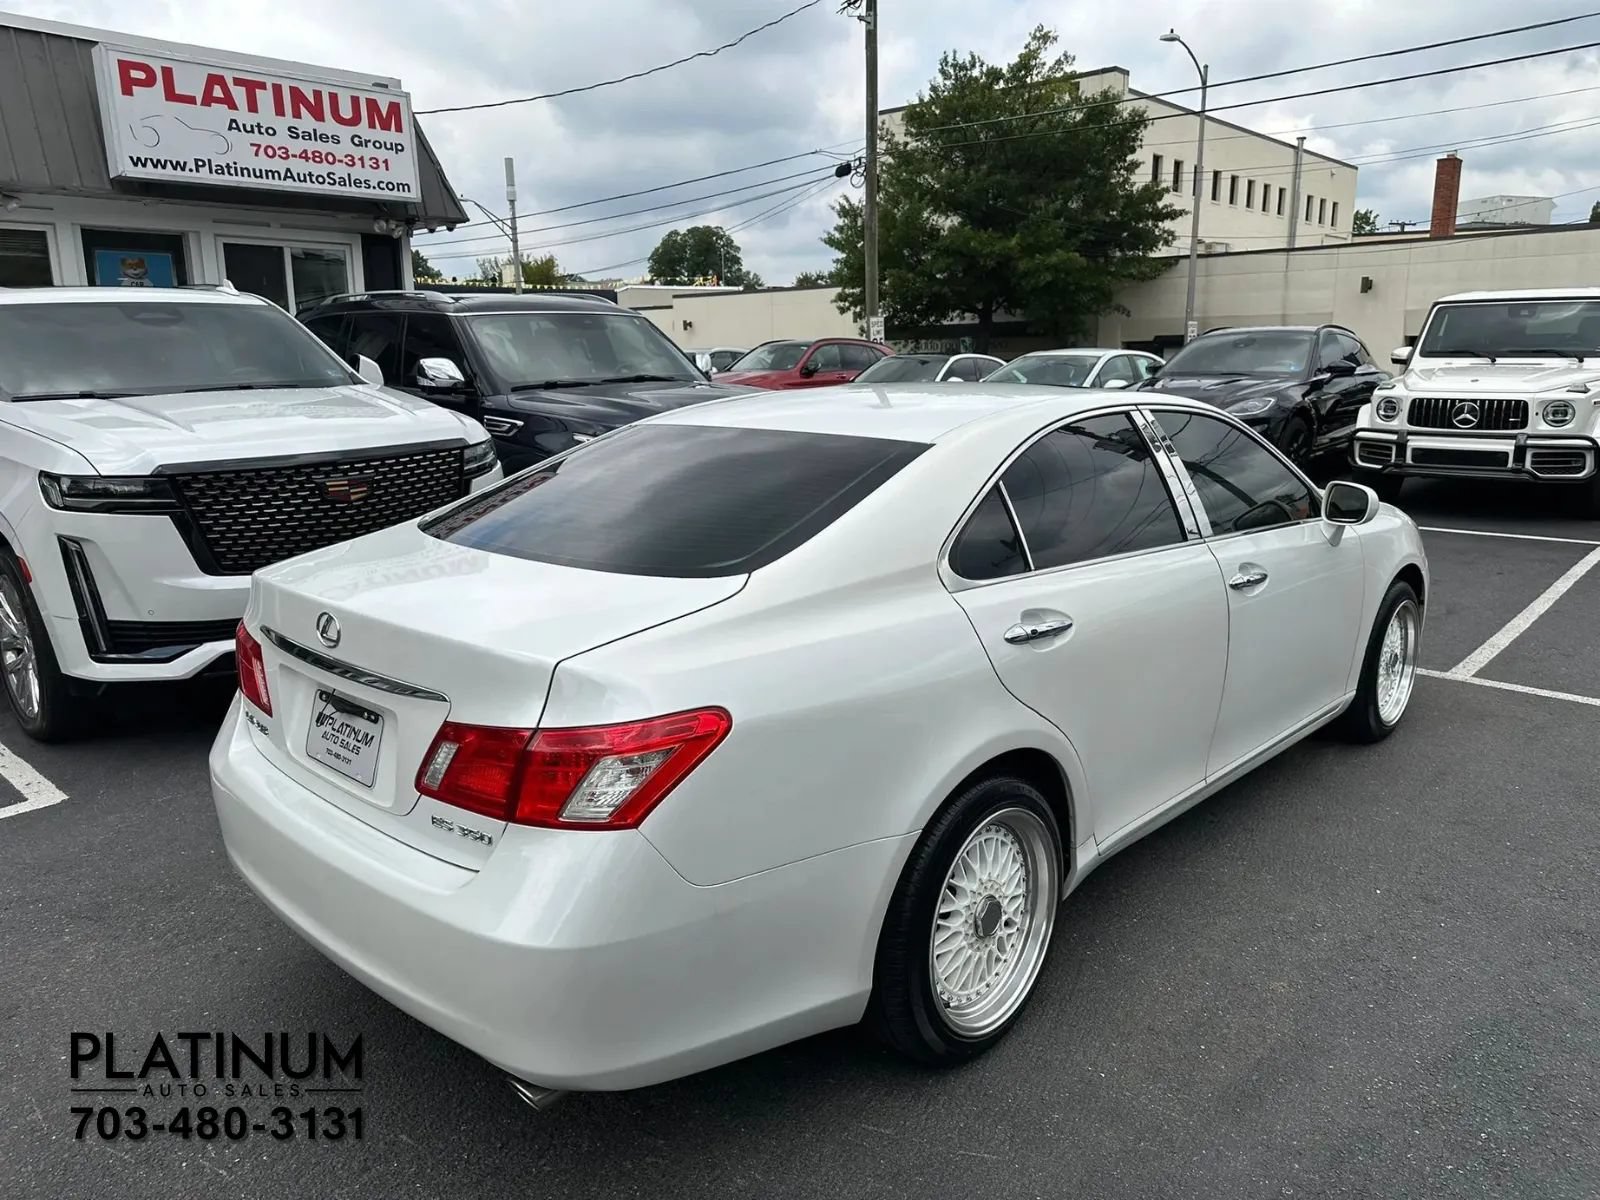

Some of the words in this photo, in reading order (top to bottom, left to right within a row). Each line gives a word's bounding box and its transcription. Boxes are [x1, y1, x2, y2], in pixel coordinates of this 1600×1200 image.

[117, 58, 403, 133] PLATINUM
[227, 118, 277, 137] Auto
[287, 125, 341, 145] Sales
[350, 134, 405, 154] Group
[129, 155, 411, 193] www.PlatinumAutoSales.com
[250, 143, 391, 171] 703-480-3131
[321, 730, 340, 745] AUTO
[339, 738, 361, 756] SALES
[325, 716, 375, 748] PLATINUM
